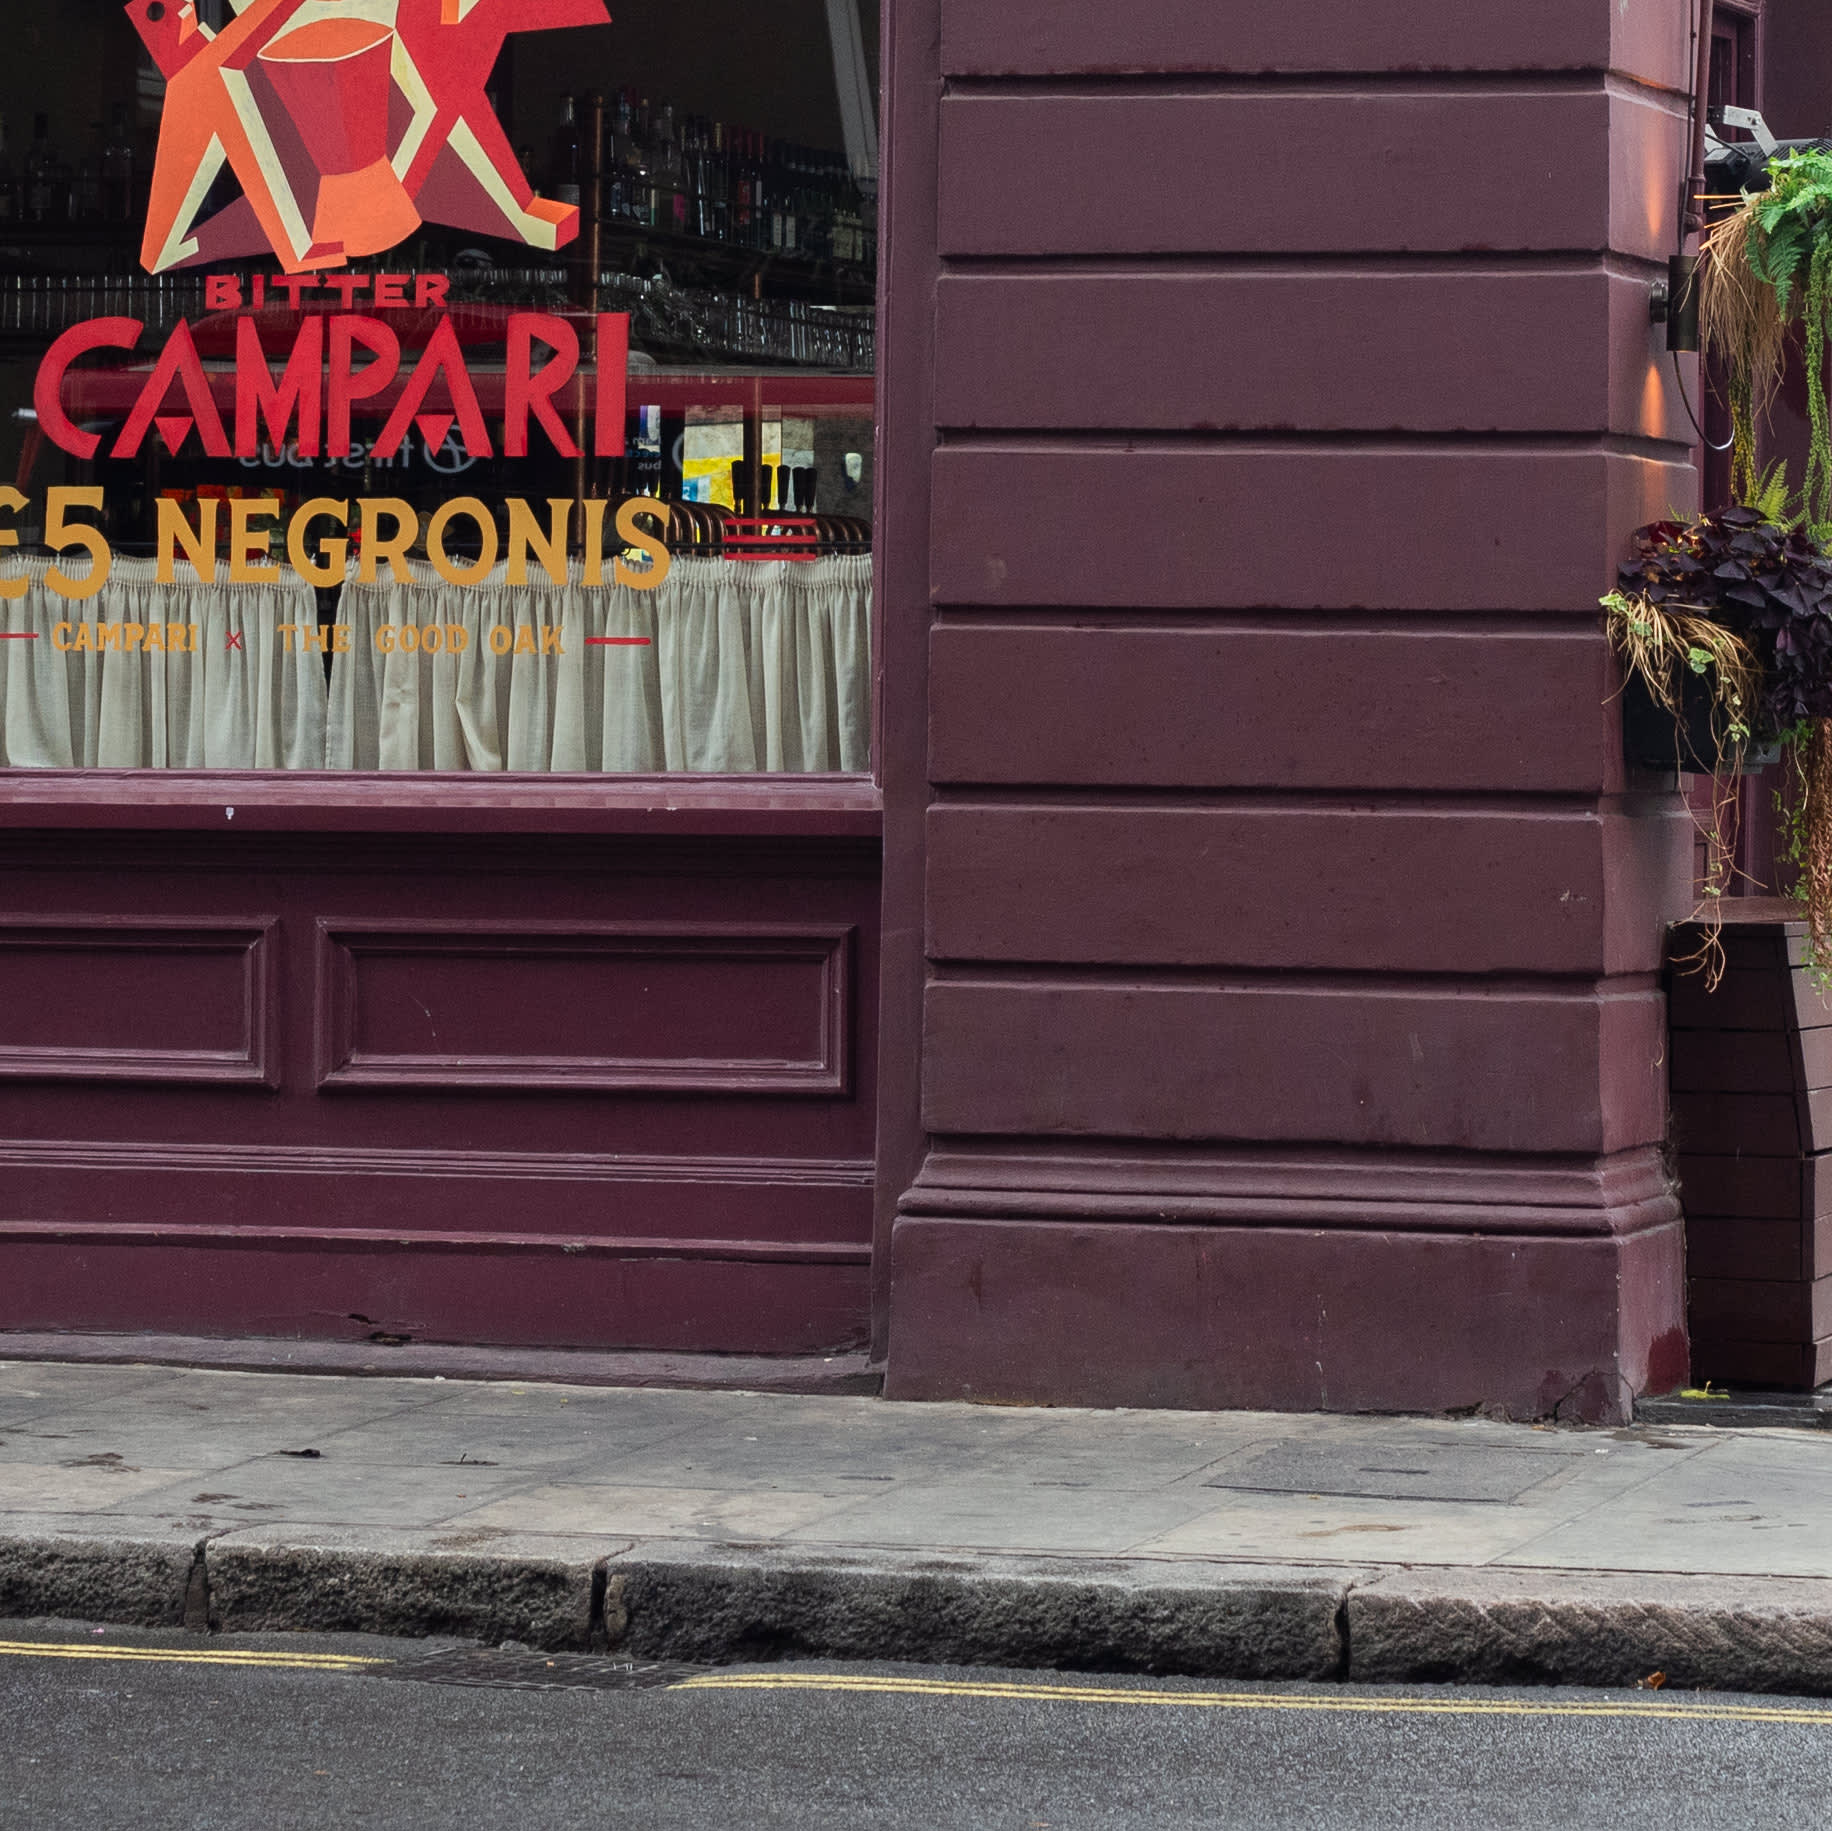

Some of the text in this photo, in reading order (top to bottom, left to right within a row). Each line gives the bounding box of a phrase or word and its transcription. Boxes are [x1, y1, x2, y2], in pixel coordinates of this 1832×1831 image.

[205, 273, 451, 310] BITTER
[32, 312, 628, 459] CAMPARI
[155, 496, 675, 591] NEGRONIS
[51, 622, 200, 653] CAMPARI
[277, 623, 351, 654] THE
[374, 623, 470, 655] GOOD
[489, 623, 567, 656] OAK
